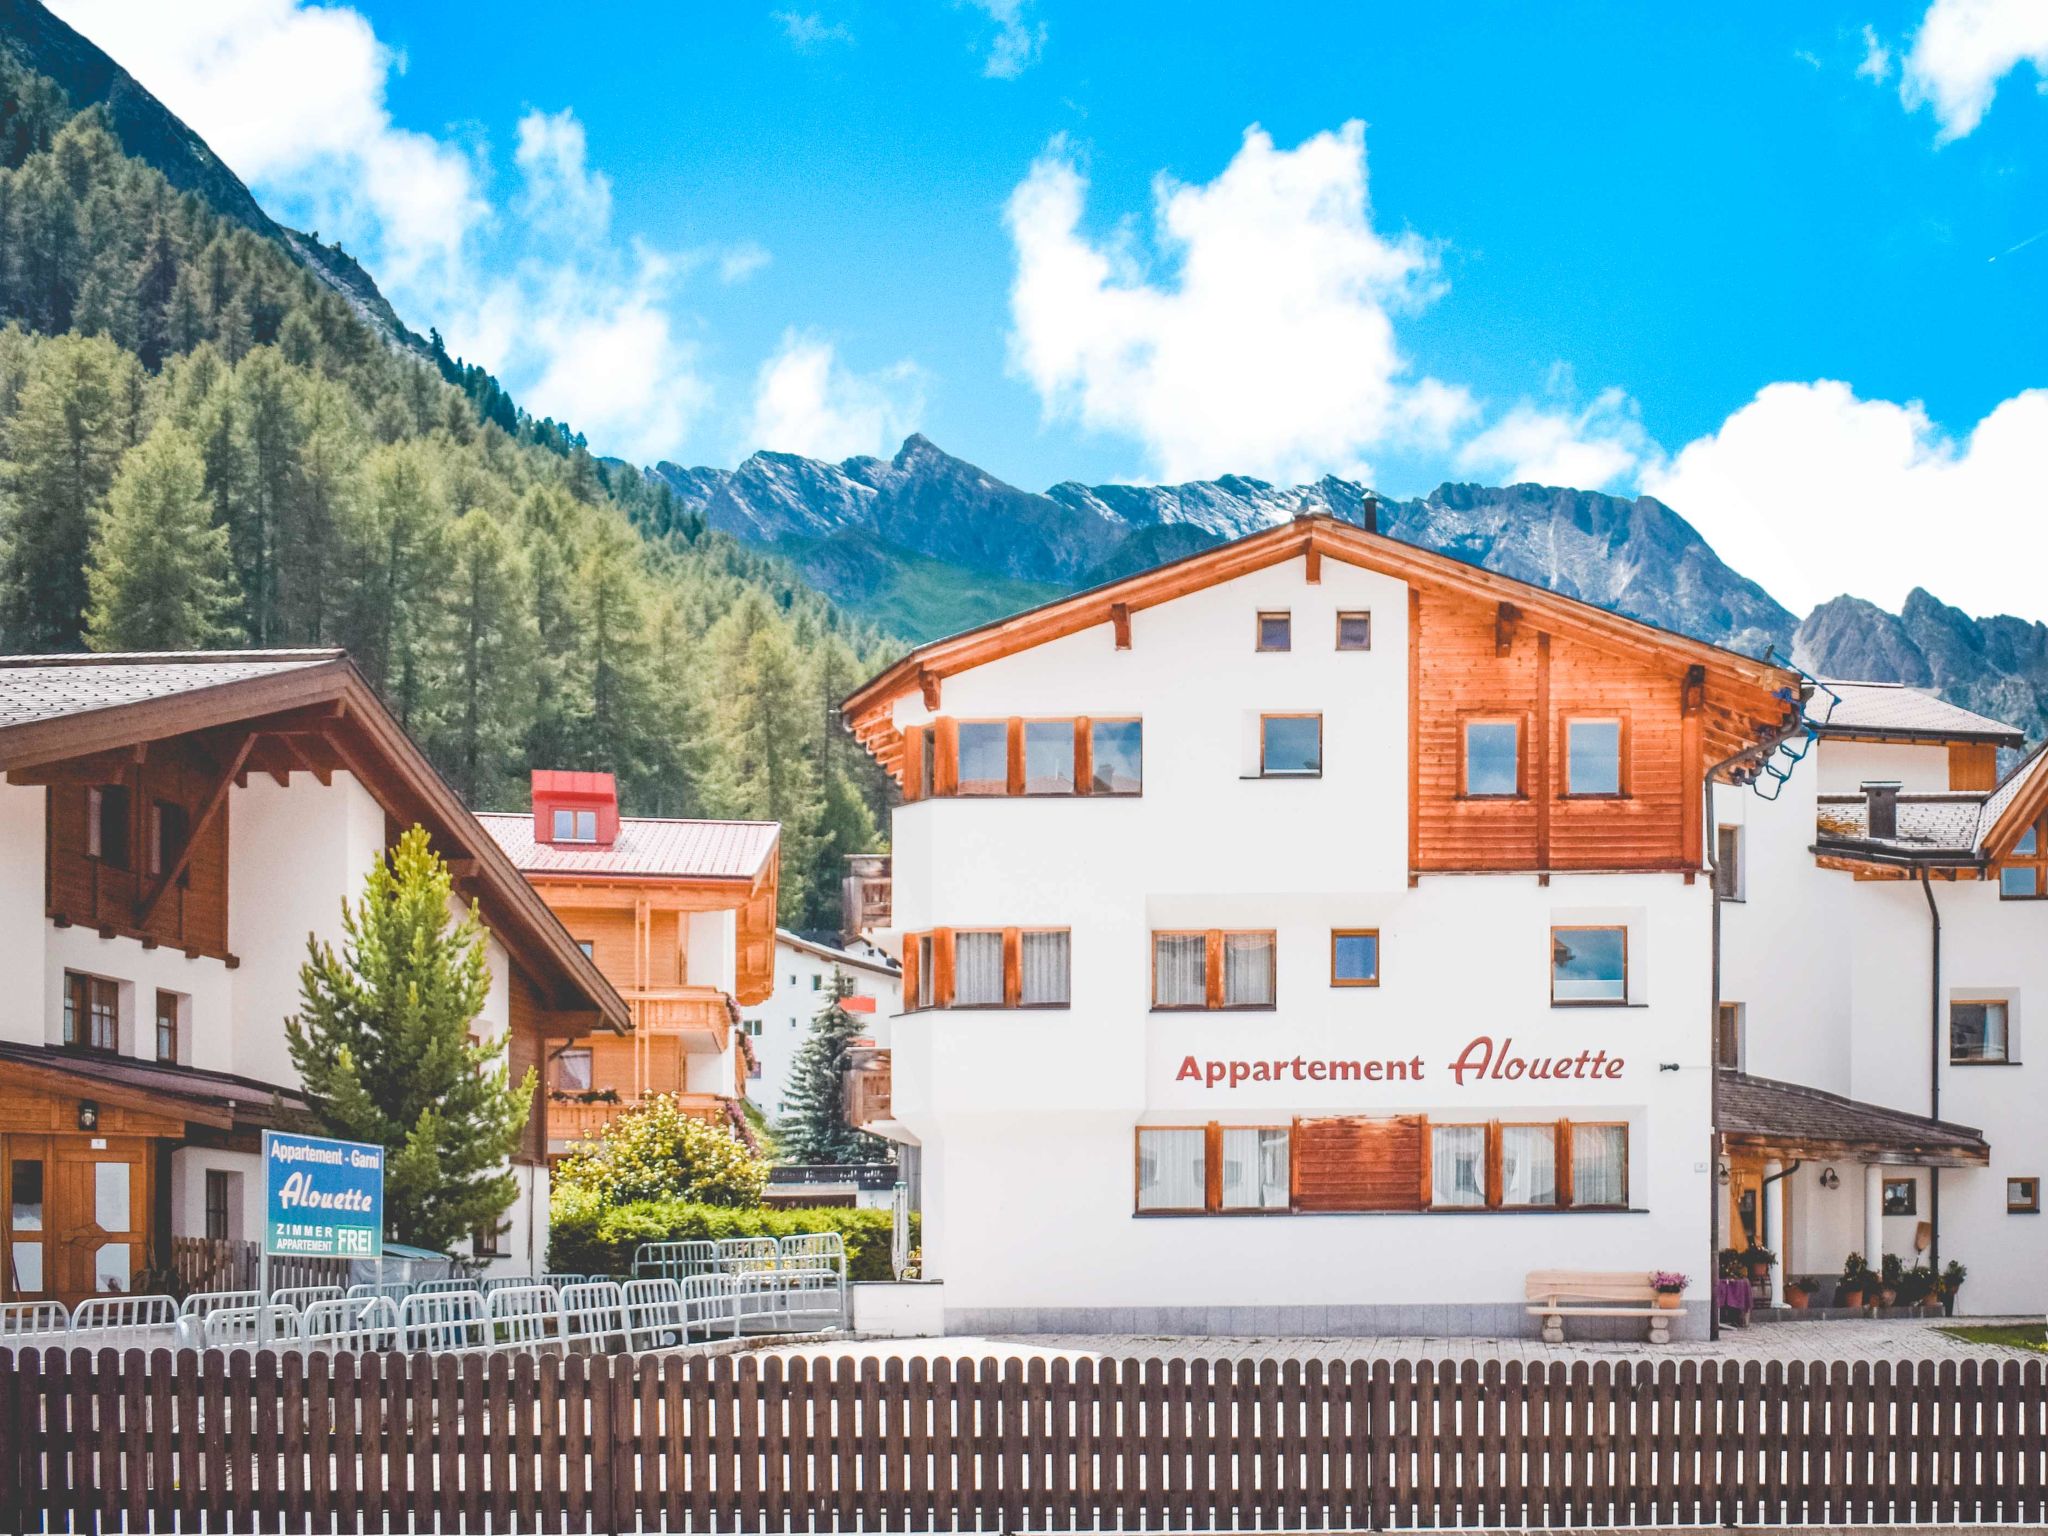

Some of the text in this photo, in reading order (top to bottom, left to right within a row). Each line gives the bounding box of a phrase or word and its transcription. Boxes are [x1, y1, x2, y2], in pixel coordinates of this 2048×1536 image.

[1176, 1036, 1624, 1089] Appartement Alouette
[271, 1139, 342, 1165] Appartement
[351, 1149, 380, 1169] Garni
[278, 1171, 372, 1212] Alouette
[276, 1223, 372, 1252] ZIMMER FREI
[276, 1238, 333, 1252] APPARTEMENT
